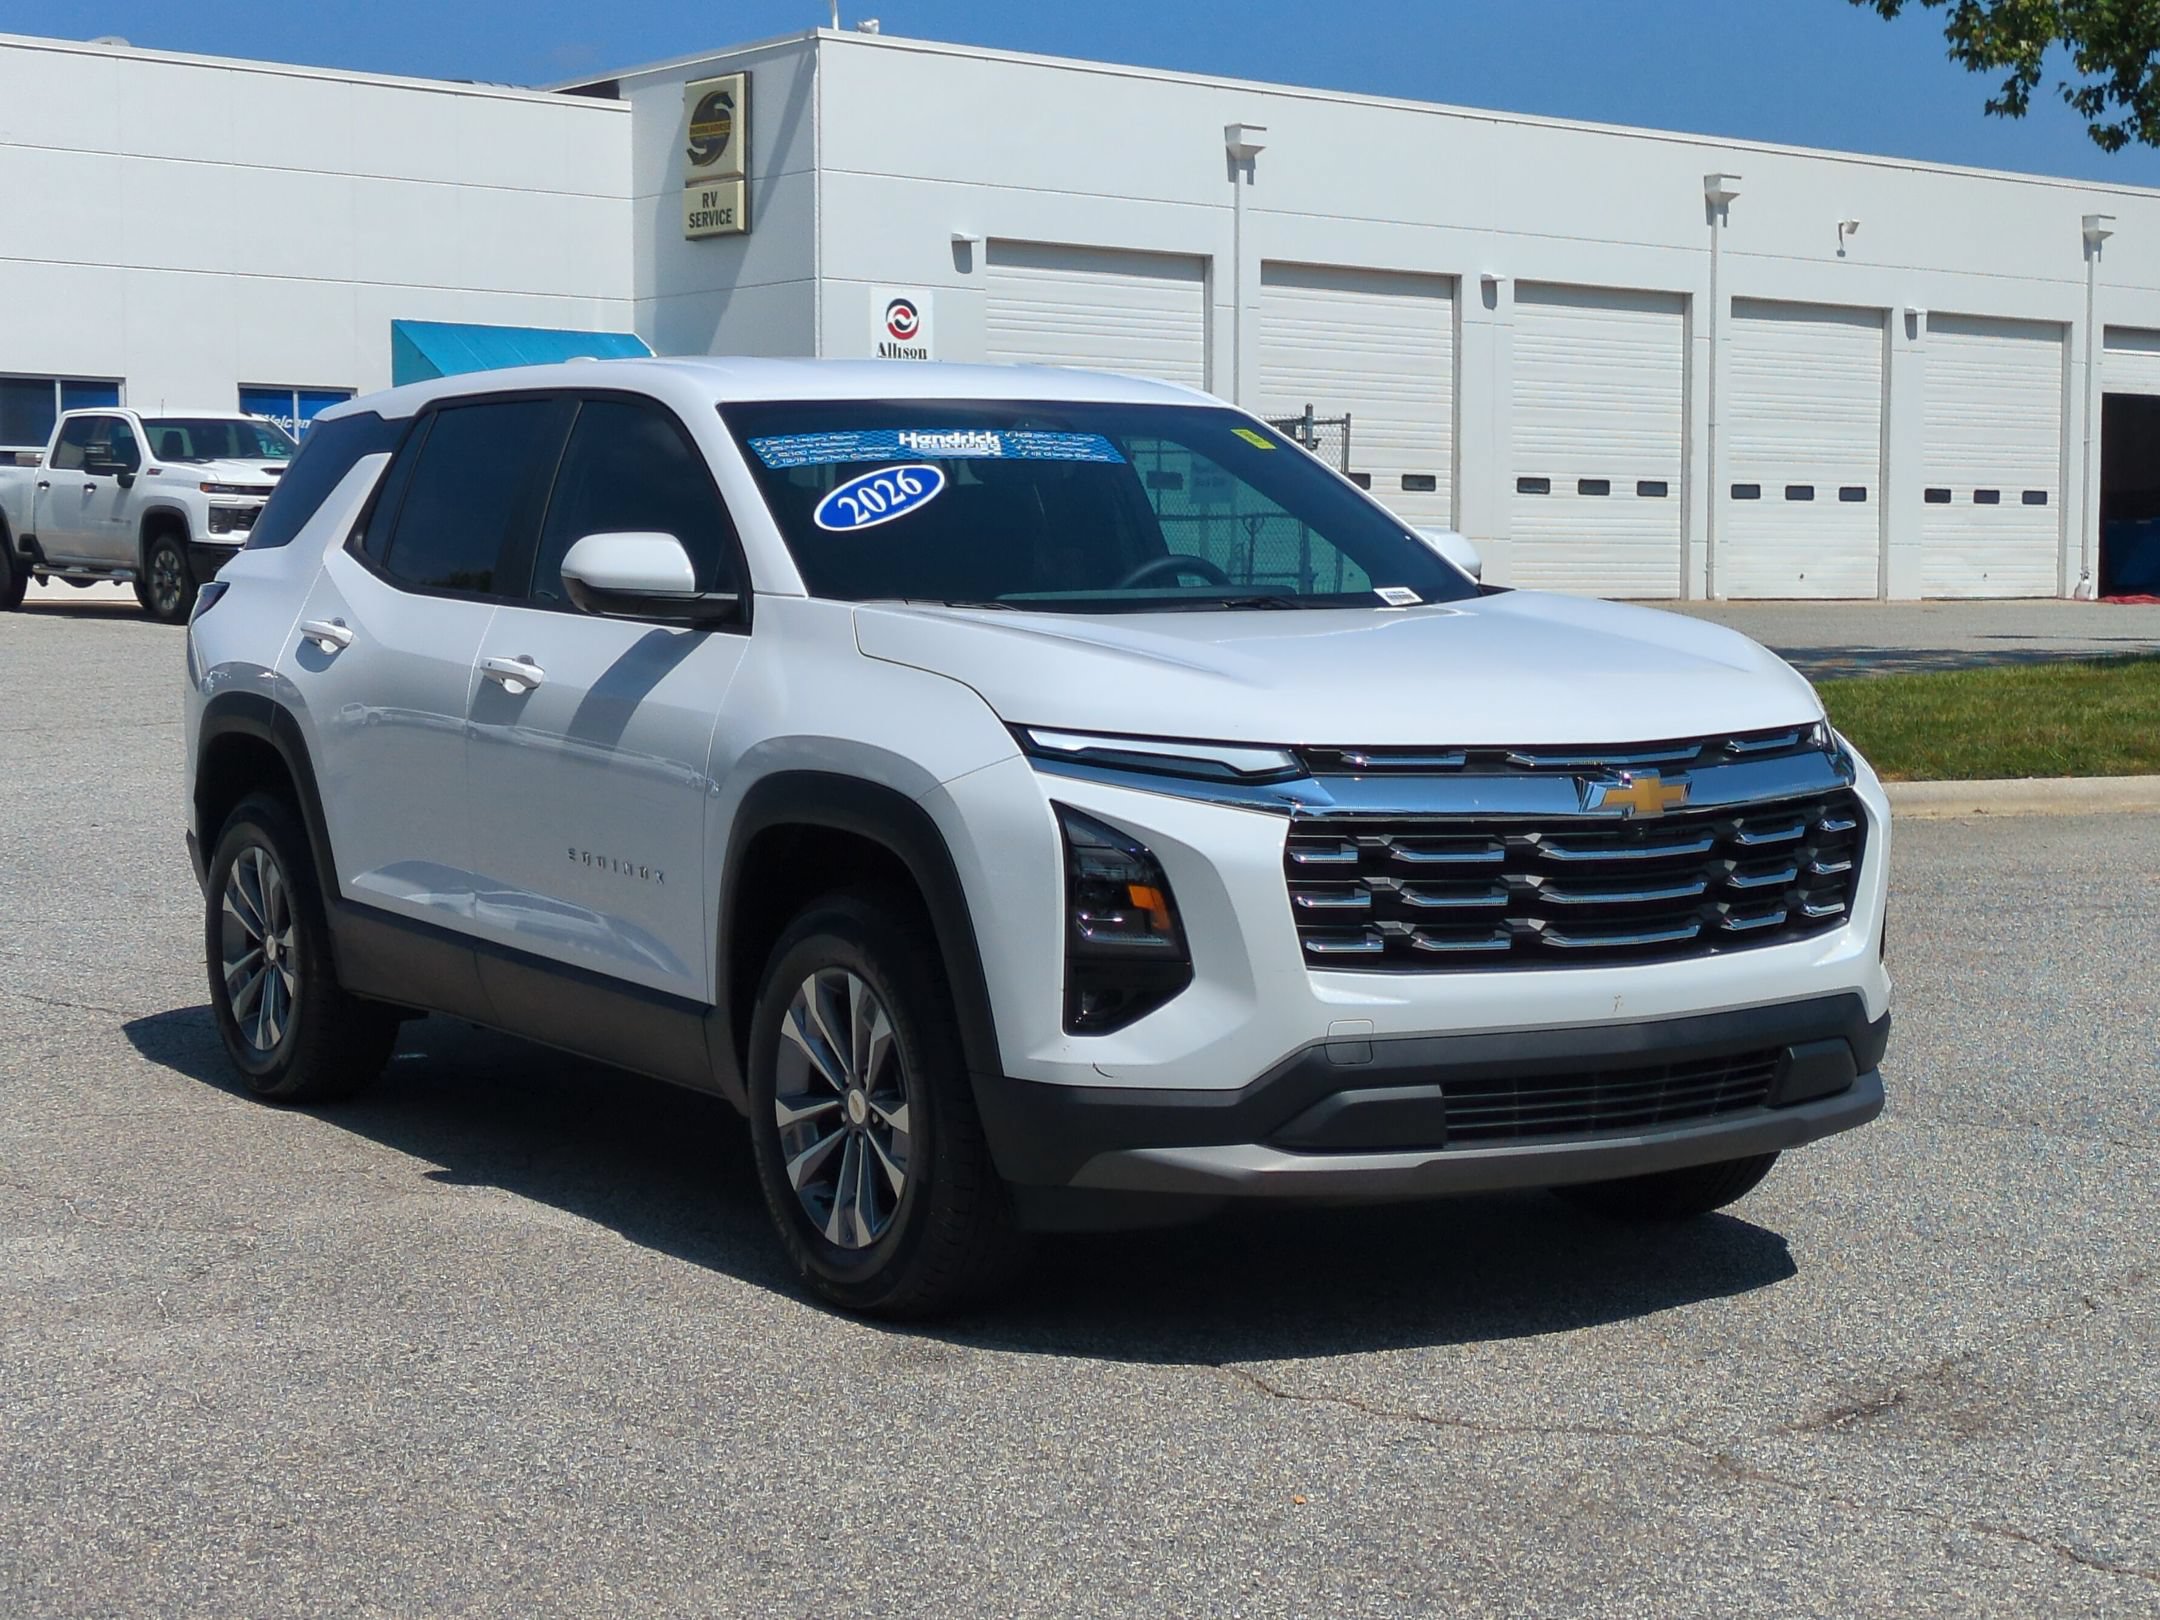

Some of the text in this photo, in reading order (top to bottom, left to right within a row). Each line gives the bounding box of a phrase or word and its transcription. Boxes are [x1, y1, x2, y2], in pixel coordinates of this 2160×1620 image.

[702, 191, 718, 208] RV
[689, 208, 732, 228] SERVICE
[877, 342, 927, 359] Allison
[899, 431, 999, 447] Hendrick
[837, 469, 922, 524] 2026
[568, 848, 664, 884] EQUINOX
